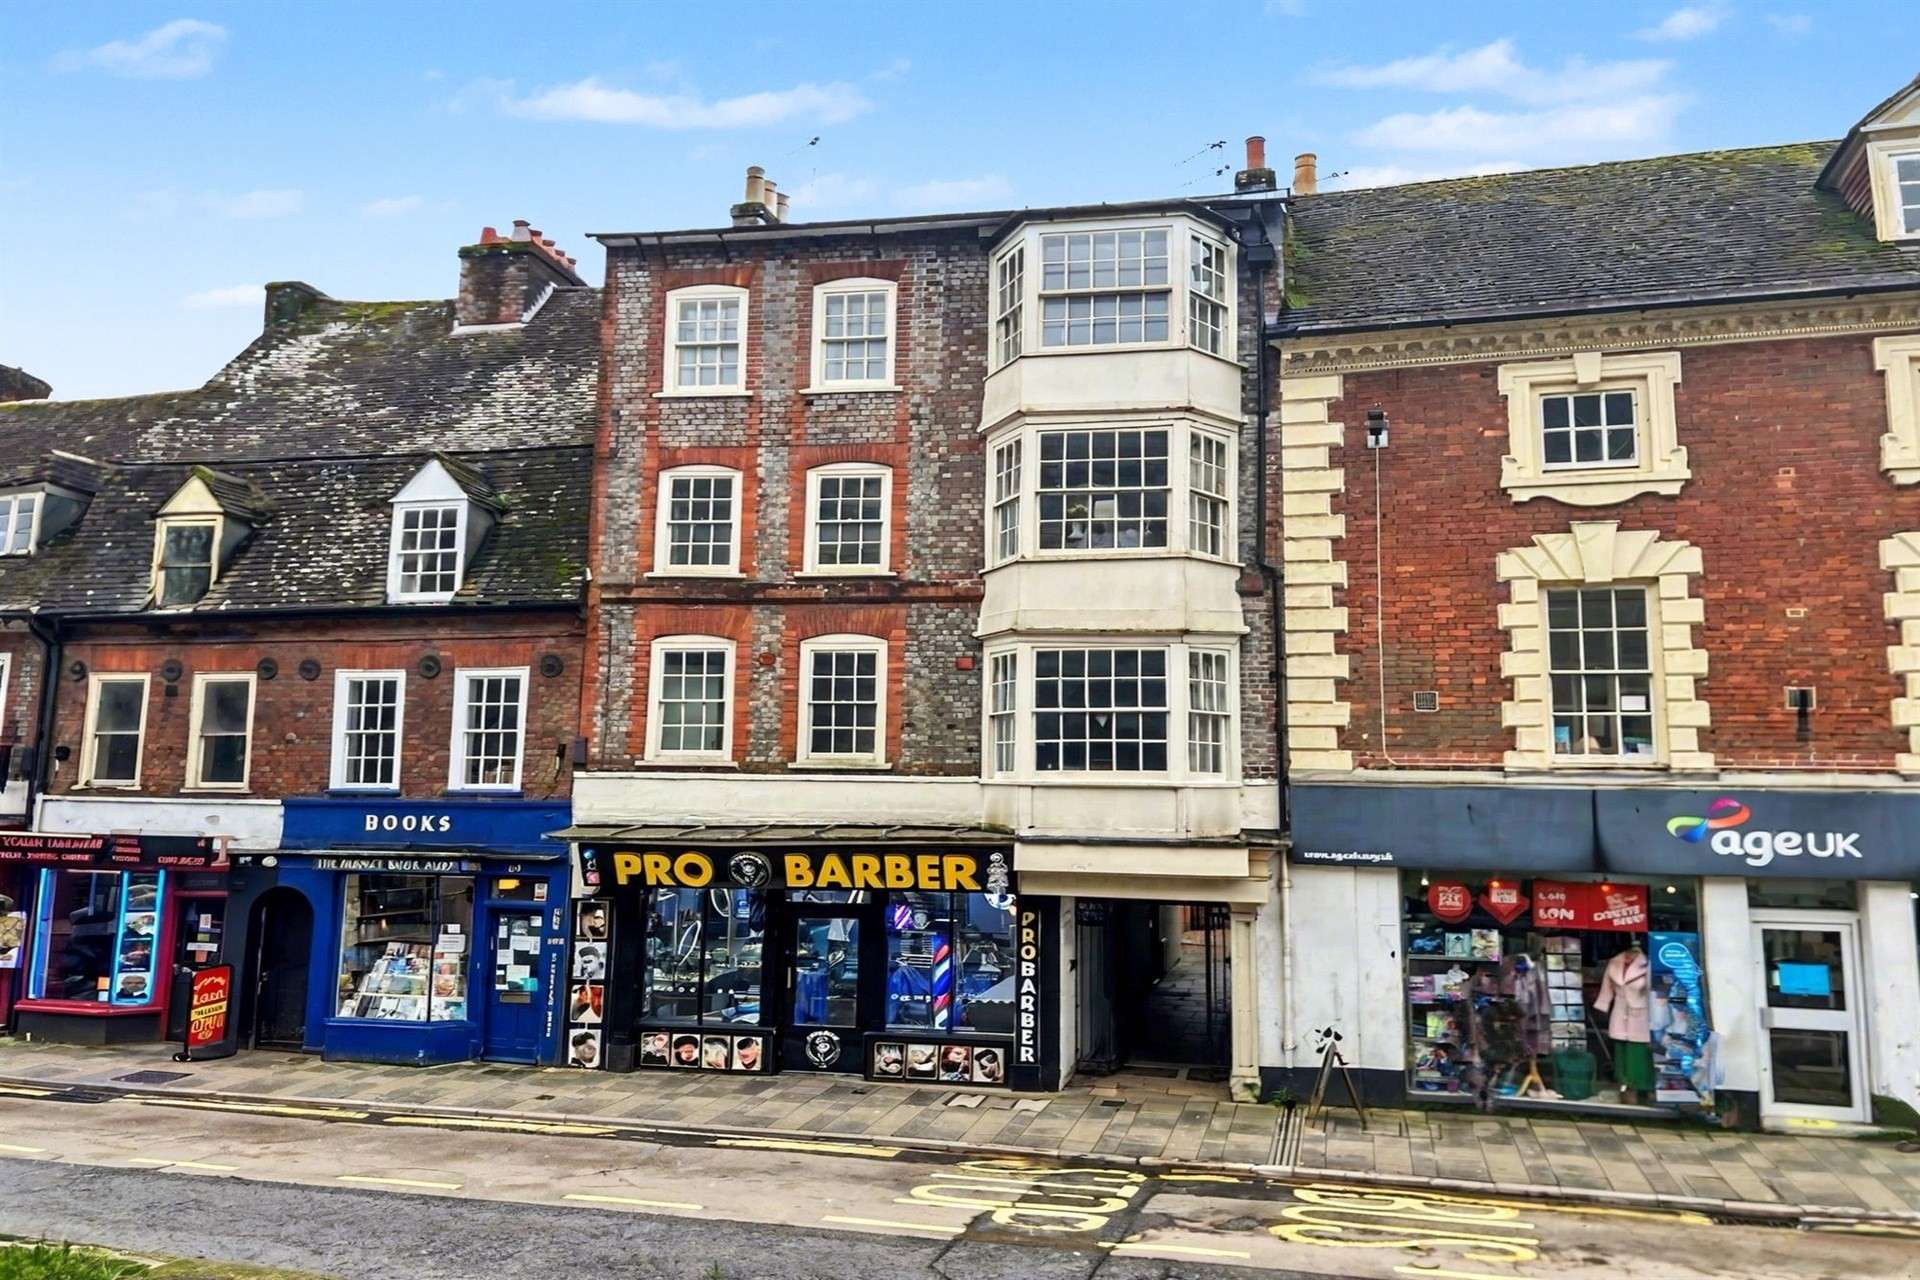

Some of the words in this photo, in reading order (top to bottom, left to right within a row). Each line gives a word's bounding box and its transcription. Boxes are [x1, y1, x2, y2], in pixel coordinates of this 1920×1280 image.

[365, 814, 451, 832] BOOKS
[1711, 829, 1803, 867] age
[1806, 832, 1863, 858] UK
[613, 851, 713, 888] PRO
[784, 852, 982, 891] BARBER
[1269, 1187, 1540, 1263] BUS
